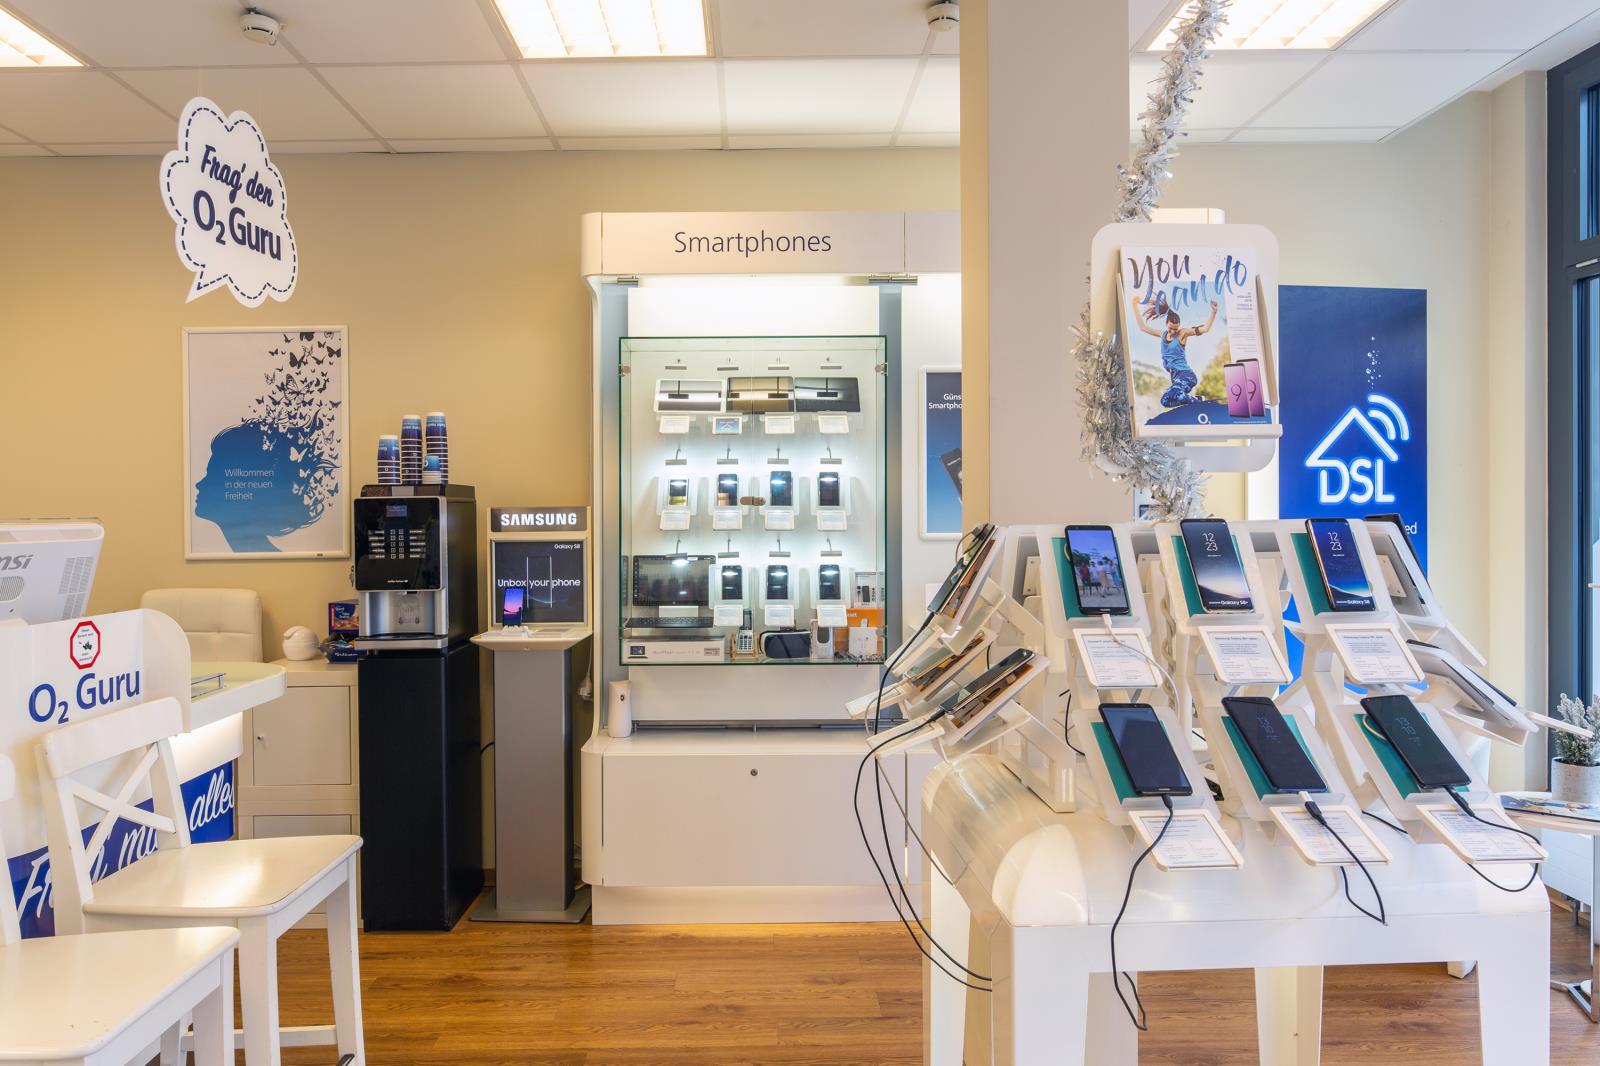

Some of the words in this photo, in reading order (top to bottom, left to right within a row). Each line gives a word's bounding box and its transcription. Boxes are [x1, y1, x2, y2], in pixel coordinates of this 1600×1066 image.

[246, 171, 274, 207] den
[229, 207, 282, 261] Guru
[674, 229, 832, 258] Smartphones
[1128, 254, 1190, 305] You
[1214, 254, 1248, 295] do
[1155, 274, 1208, 316] can
[224, 468, 274, 477] Willkommen
[224, 480, 233, 489] in
[233, 479, 246, 489] der
[247, 481, 273, 489] neuen
[1318, 458, 1395, 504] DSL
[224, 490, 253, 500] Freiheit
[500, 512, 577, 526] SAMSUNG
[1202, 532, 1216, 542] 12
[1327, 531, 1339, 542] 12
[1205, 541, 1218, 552] 23
[1329, 541, 1342, 551] 23
[497, 578, 527, 588] Unbox
[528, 580, 550, 589] your
[551, 578, 581, 589] phone
[76, 671, 140, 710] Guru
